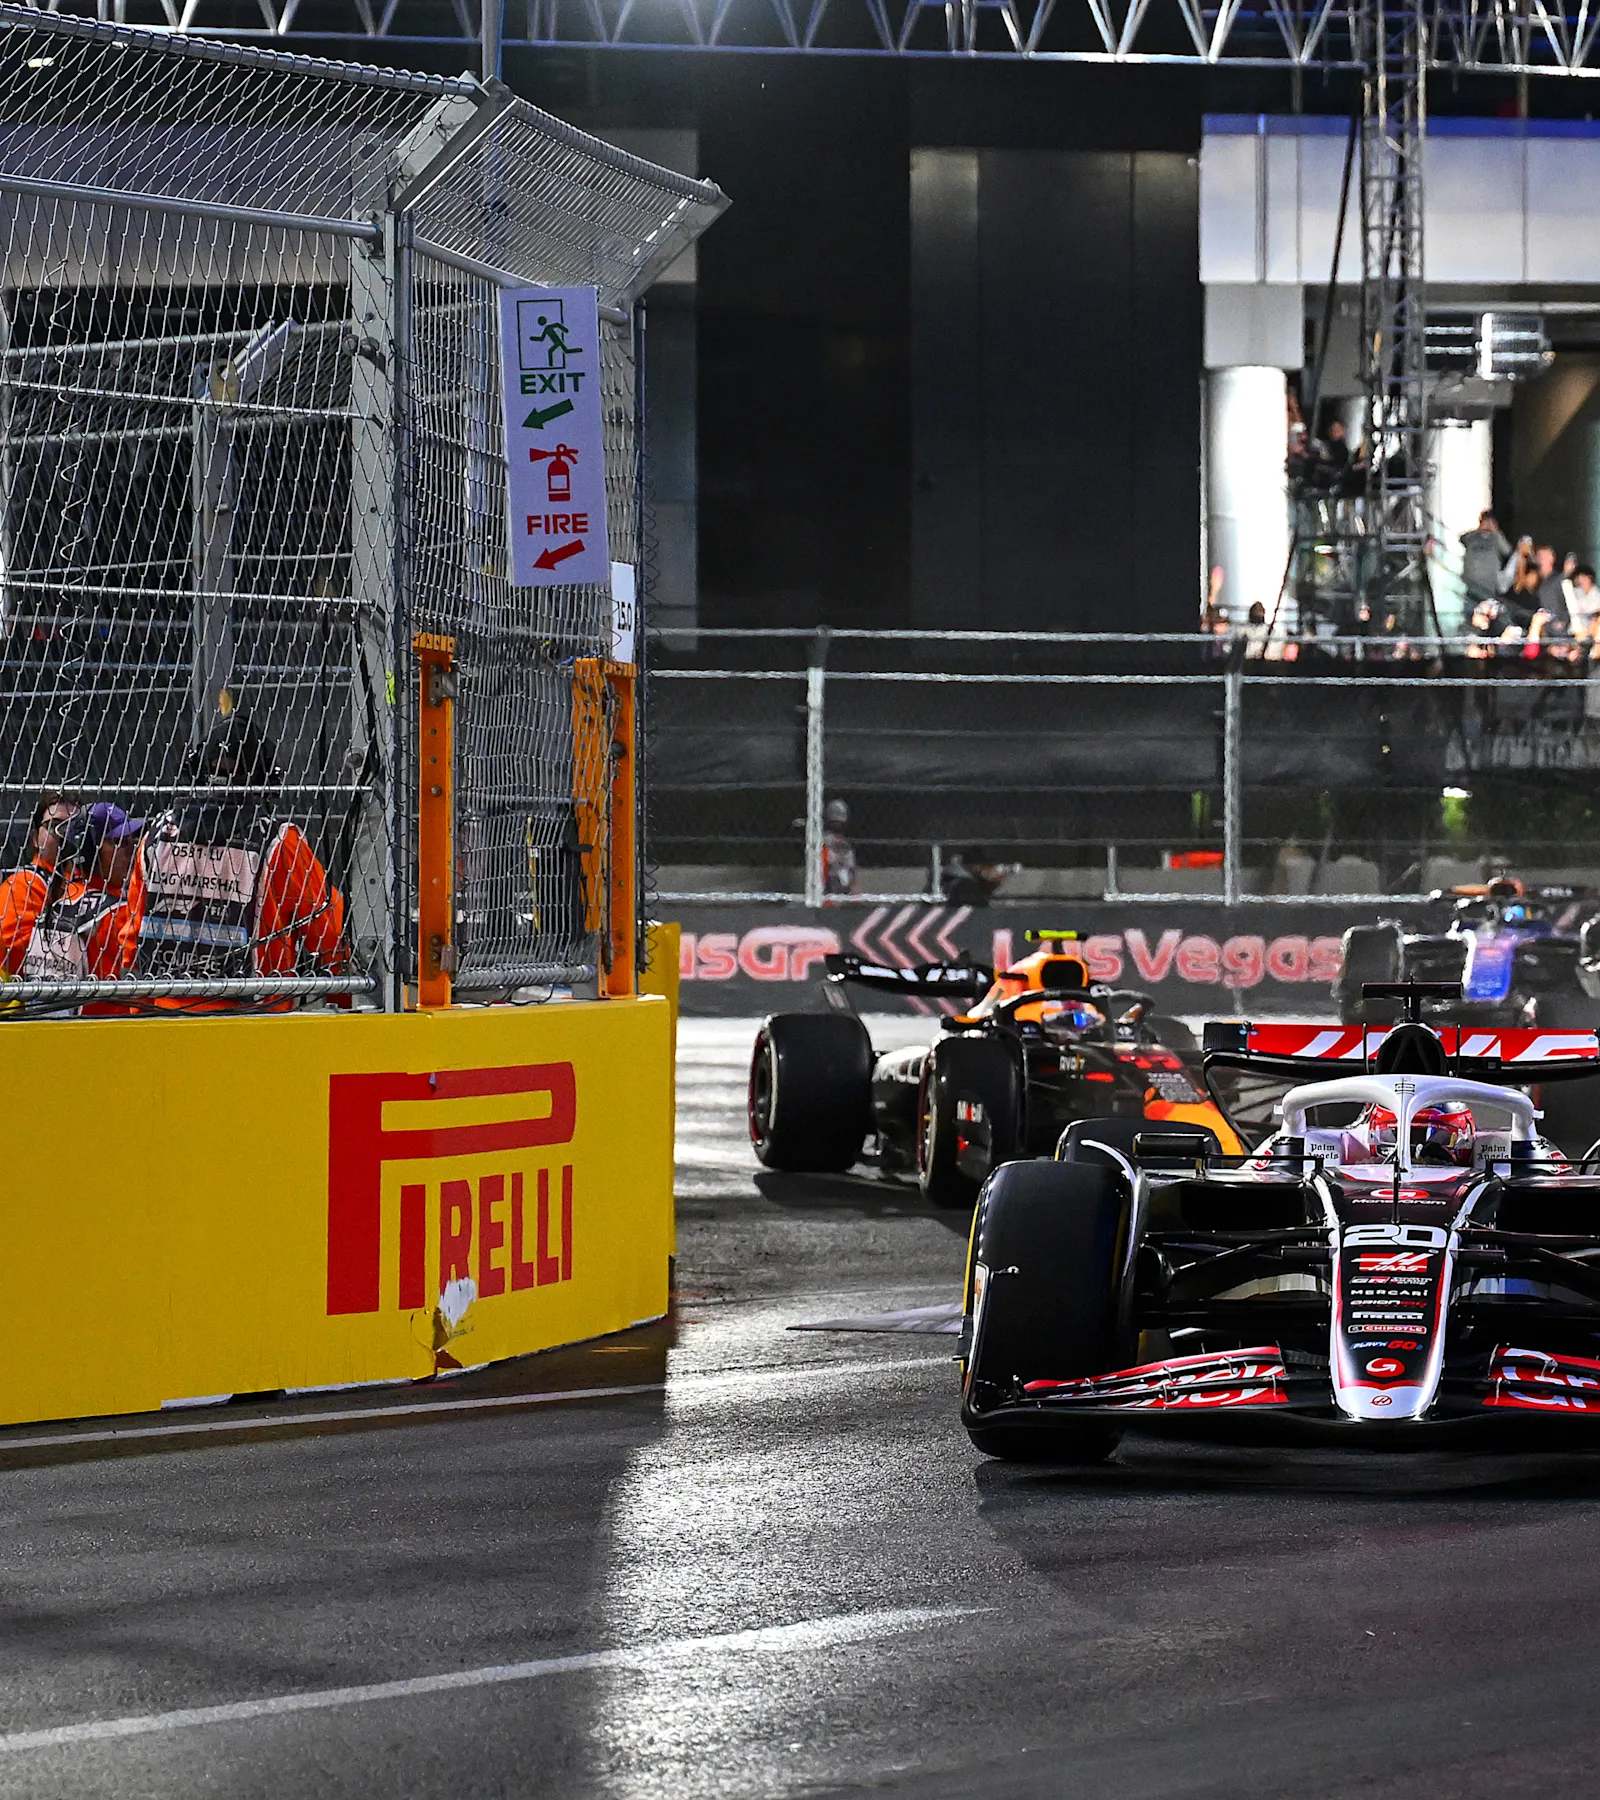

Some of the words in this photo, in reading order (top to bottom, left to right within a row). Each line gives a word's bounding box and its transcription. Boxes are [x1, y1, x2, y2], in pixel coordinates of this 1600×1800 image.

[520, 372, 585, 394] EXIT
[527, 513, 588, 535] FIRE
[1310, 1143, 1335, 1151] Palm
[1481, 1144, 1506, 1152] Palm
[326, 1061, 577, 1316] PIRELLI
[1343, 1224, 1447, 1249] 20
[1387, 1341, 1417, 1350] GO
